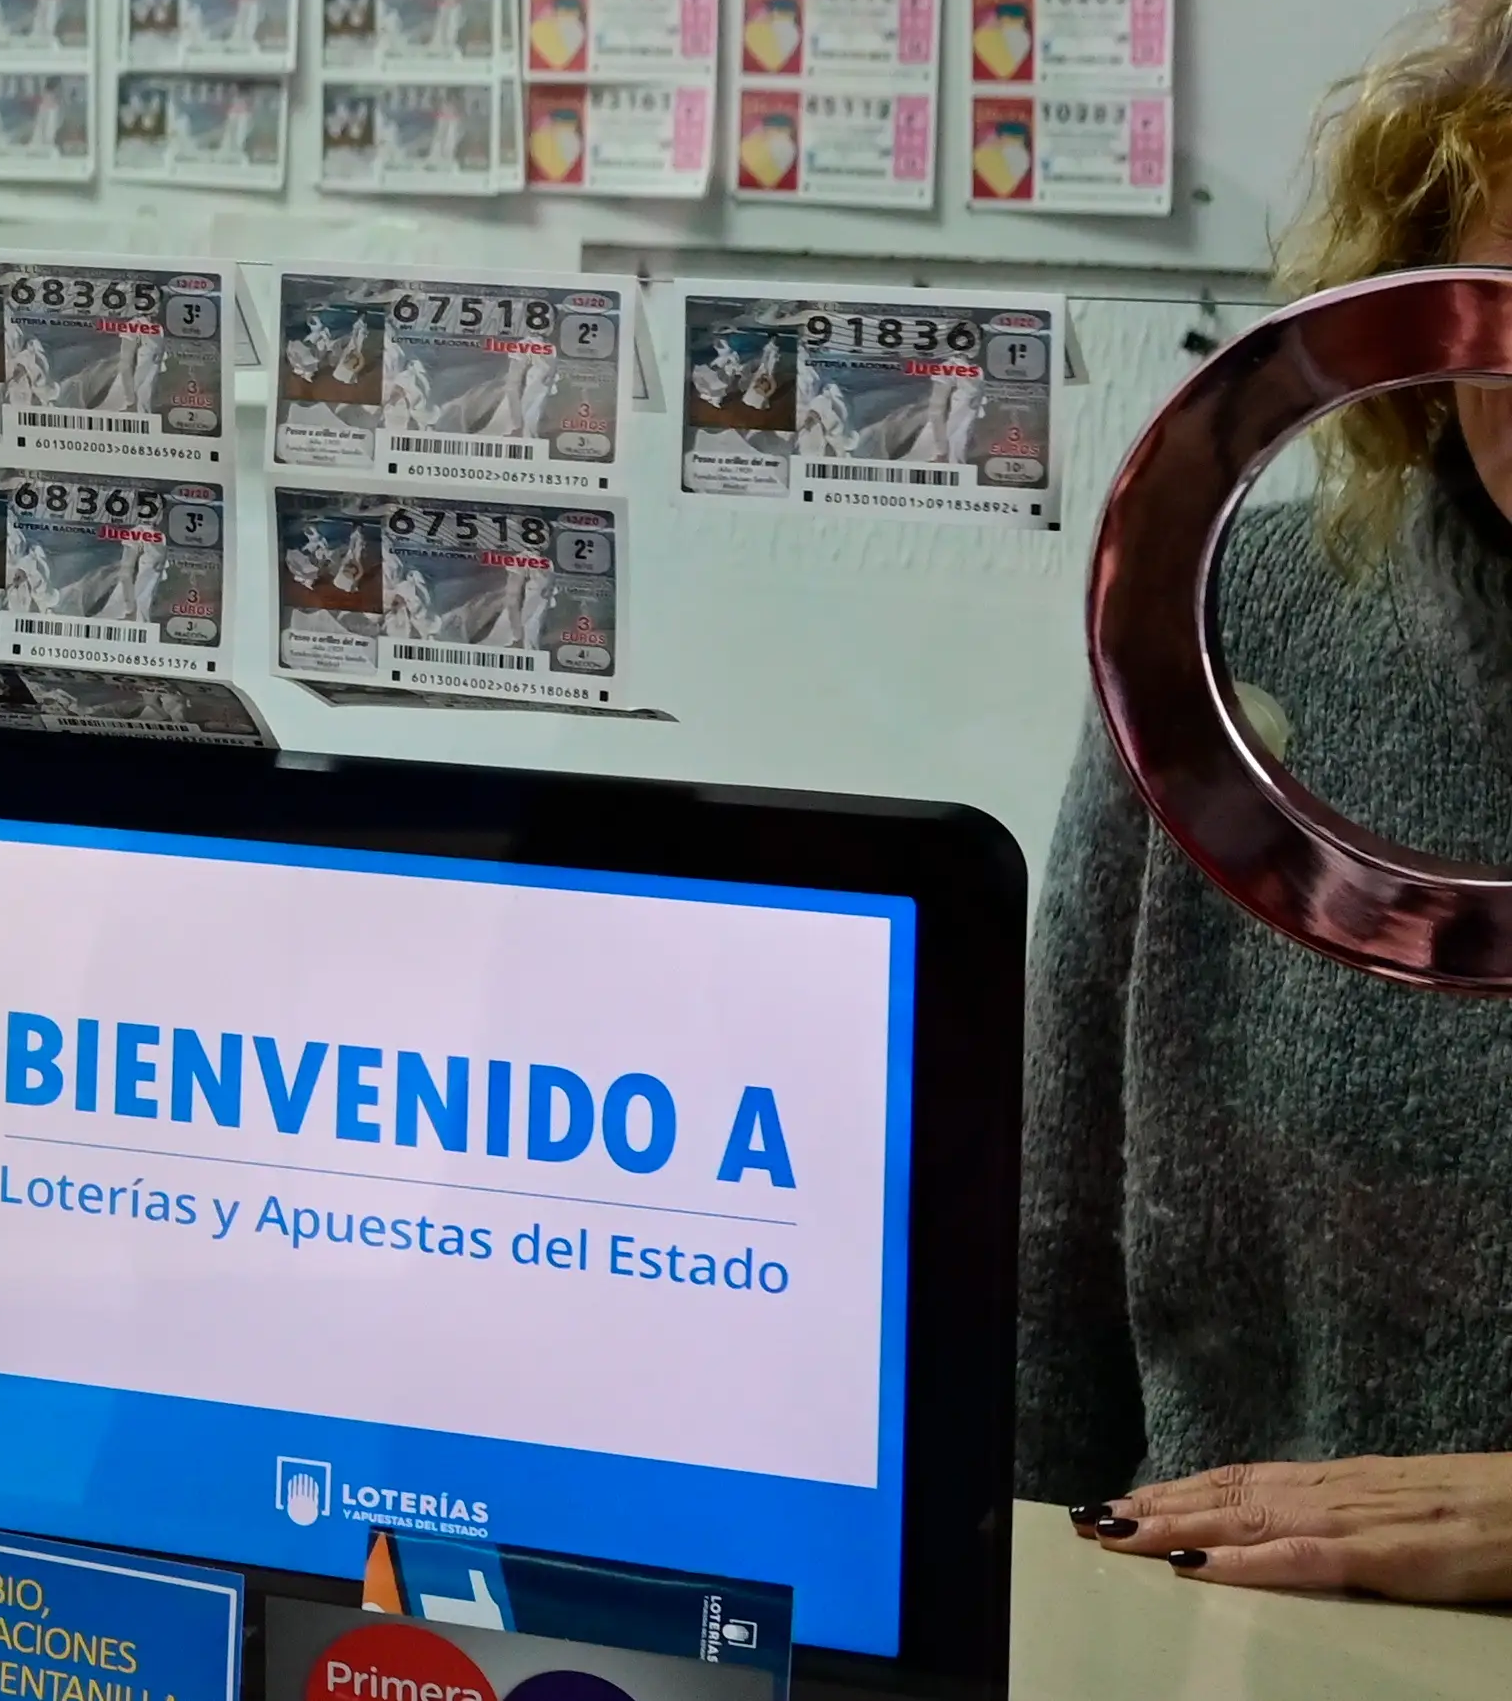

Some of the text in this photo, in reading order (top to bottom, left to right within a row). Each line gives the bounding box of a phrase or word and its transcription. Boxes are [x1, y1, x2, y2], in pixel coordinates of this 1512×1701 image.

[11, 278, 157, 312] 68365
[393, 295, 551, 330] 67518
[806, 316, 977, 351] 91836
[904, 360, 980, 378] Jueves
[4, 1010, 798, 1189] BIENVENIDO A
[0, 1163, 791, 1295] Loterías y Apuestas del Estado
[342, 1483, 489, 1524] LOTERÍAS
[344, 1509, 488, 1539] Y APUESTAS DEL ESTADO
[326, 1661, 482, 1701] Primera
